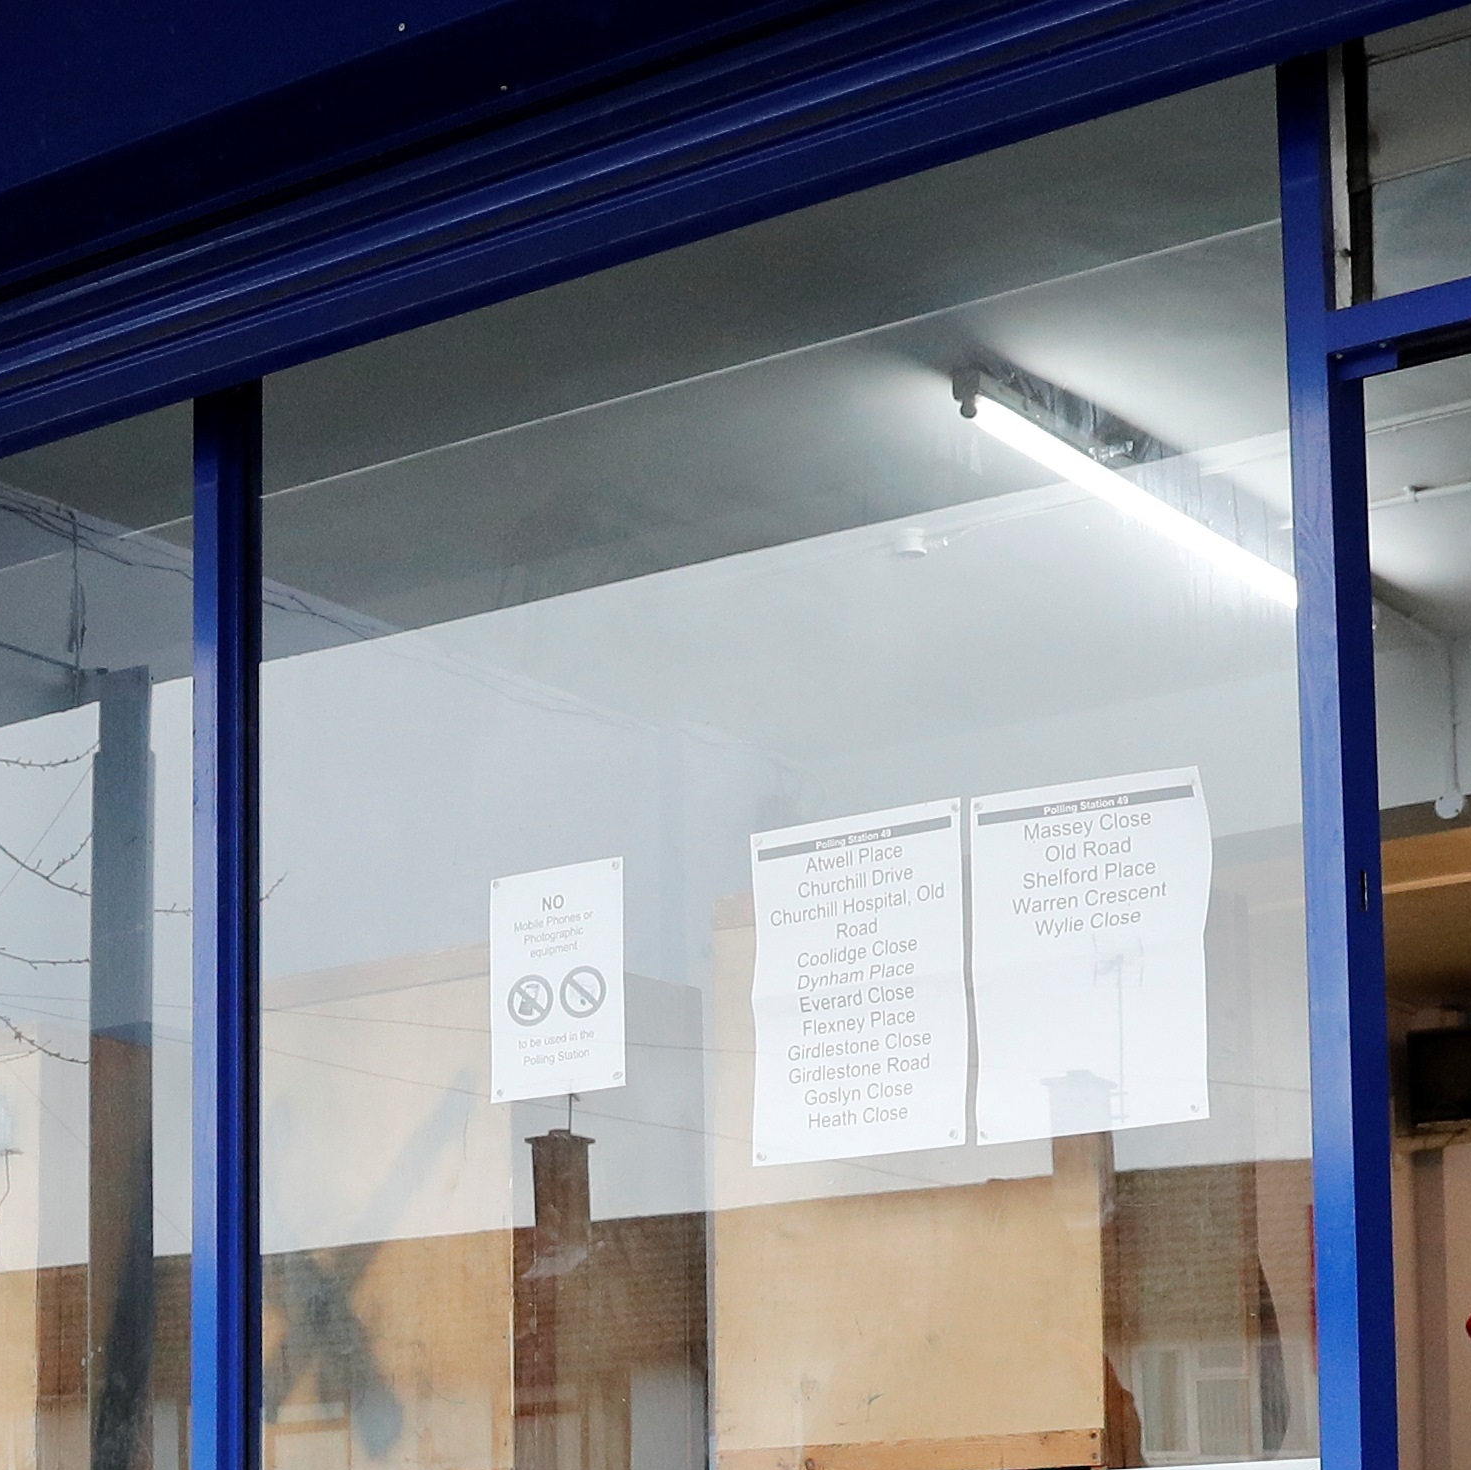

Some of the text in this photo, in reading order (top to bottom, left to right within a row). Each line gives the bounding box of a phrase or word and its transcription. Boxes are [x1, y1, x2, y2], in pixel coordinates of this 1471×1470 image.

[1043, 796, 1129, 816] Polling Station 49
[1023, 812, 1151, 841] Massey Close
[815, 836, 846, 850] Polling
[848, 831, 879, 844] Station
[1045, 836, 1131, 862] Old Road
[805, 845, 903, 874] Atwell Place
[798, 867, 913, 898] Churchill Drive
[1022, 861, 1156, 890] Shelford Place
[541, 894, 565, 912] NO
[770, 882, 944, 926] Churchill Hospital, Old
[1012, 881, 1167, 915] Warren Crescent
[514, 911, 594, 932] Mobile Phones or
[836, 918, 878, 939] Road
[1035, 910, 1141, 938] Wylie Close
[523, 926, 584, 946] Photographic
[530, 941, 578, 958] equipment
[797, 939, 917, 968] Coolidge Close
[797, 962, 915, 992] Dynham Place
[799, 985, 915, 1013] Everard Close
[802, 1010, 916, 1036] Flexney Place
[518, 1028, 595, 1049] to be used in the
[787, 1032, 931, 1061] Girdlestone Close
[523, 1048, 590, 1066] Polling Station
[788, 1053, 930, 1084] Girdlestone Road
[804, 1081, 913, 1106] Goslyn Close
[808, 1106, 908, 1129] Heath Close
